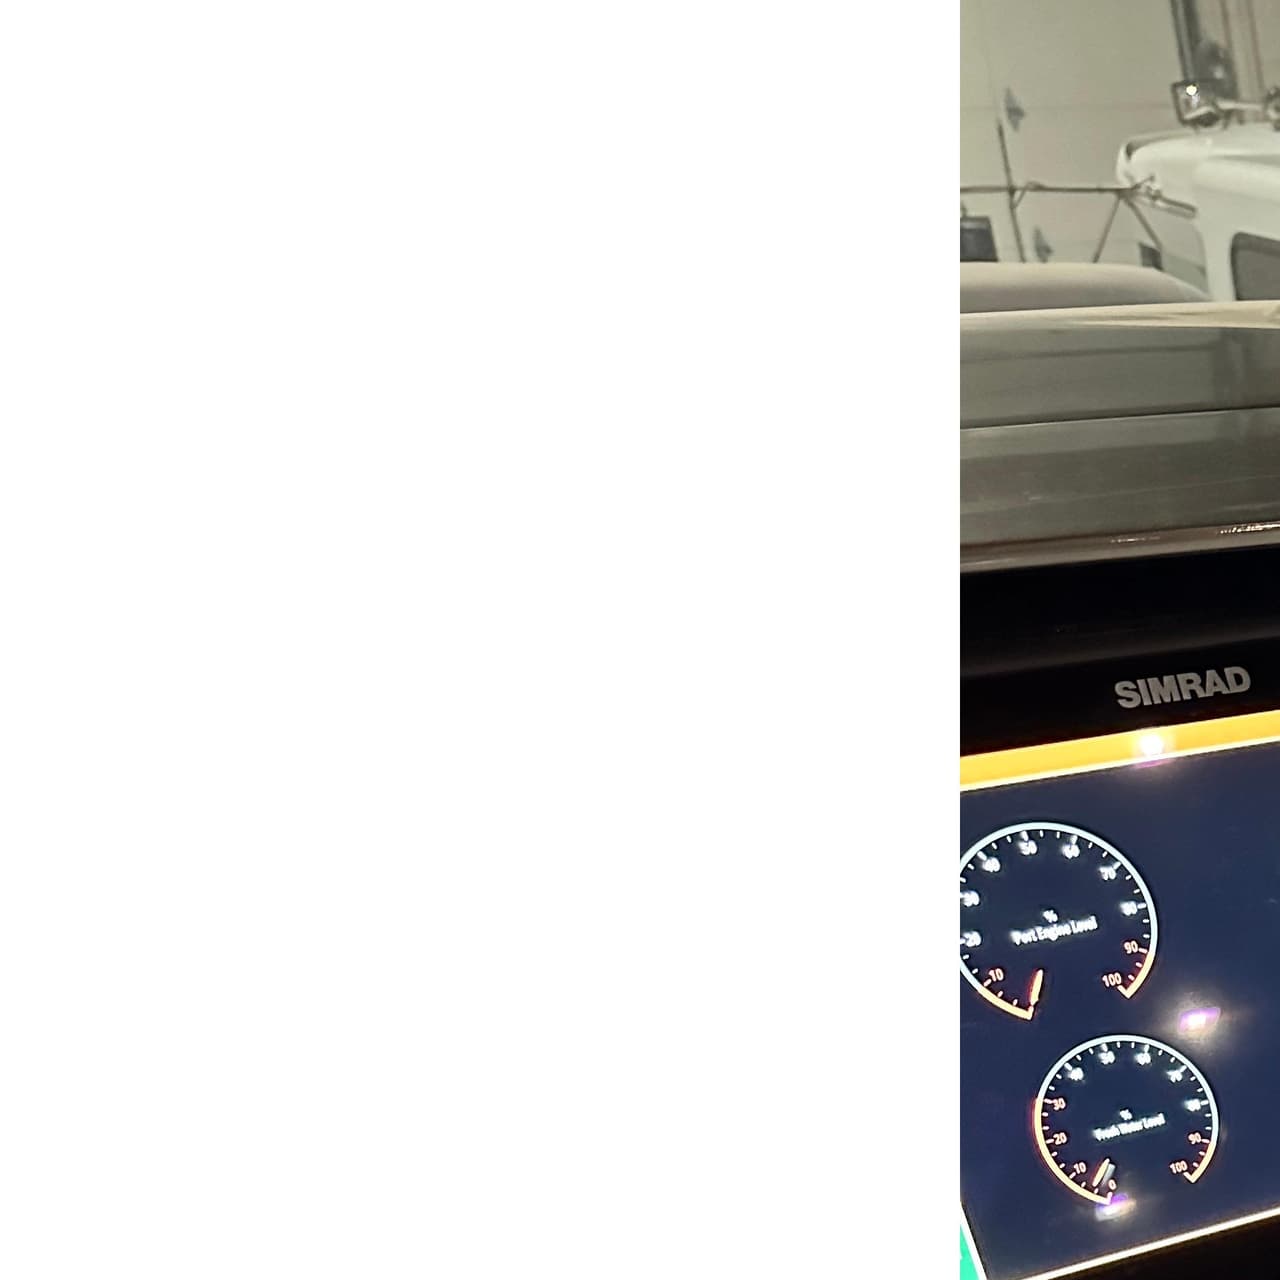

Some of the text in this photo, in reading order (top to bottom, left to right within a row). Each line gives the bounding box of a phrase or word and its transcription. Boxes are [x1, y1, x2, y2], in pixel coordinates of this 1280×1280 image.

[1114, 665, 1251, 709] SIMRAD
[1010, 915, 1099, 946] Port Engine Level
[1123, 940, 1139, 955] 90
[988, 968, 1005, 983] 10
[1102, 972, 1123, 988] 100
[1053, 1097, 1066, 1111] 30
[1053, 1131, 1067, 1145] 20
[1188, 1131, 1202, 1145] 90
[1073, 1161, 1087, 1175] 10
[1169, 1160, 1188, 1174] 100
[1108, 1179, 1117, 1190] 0
